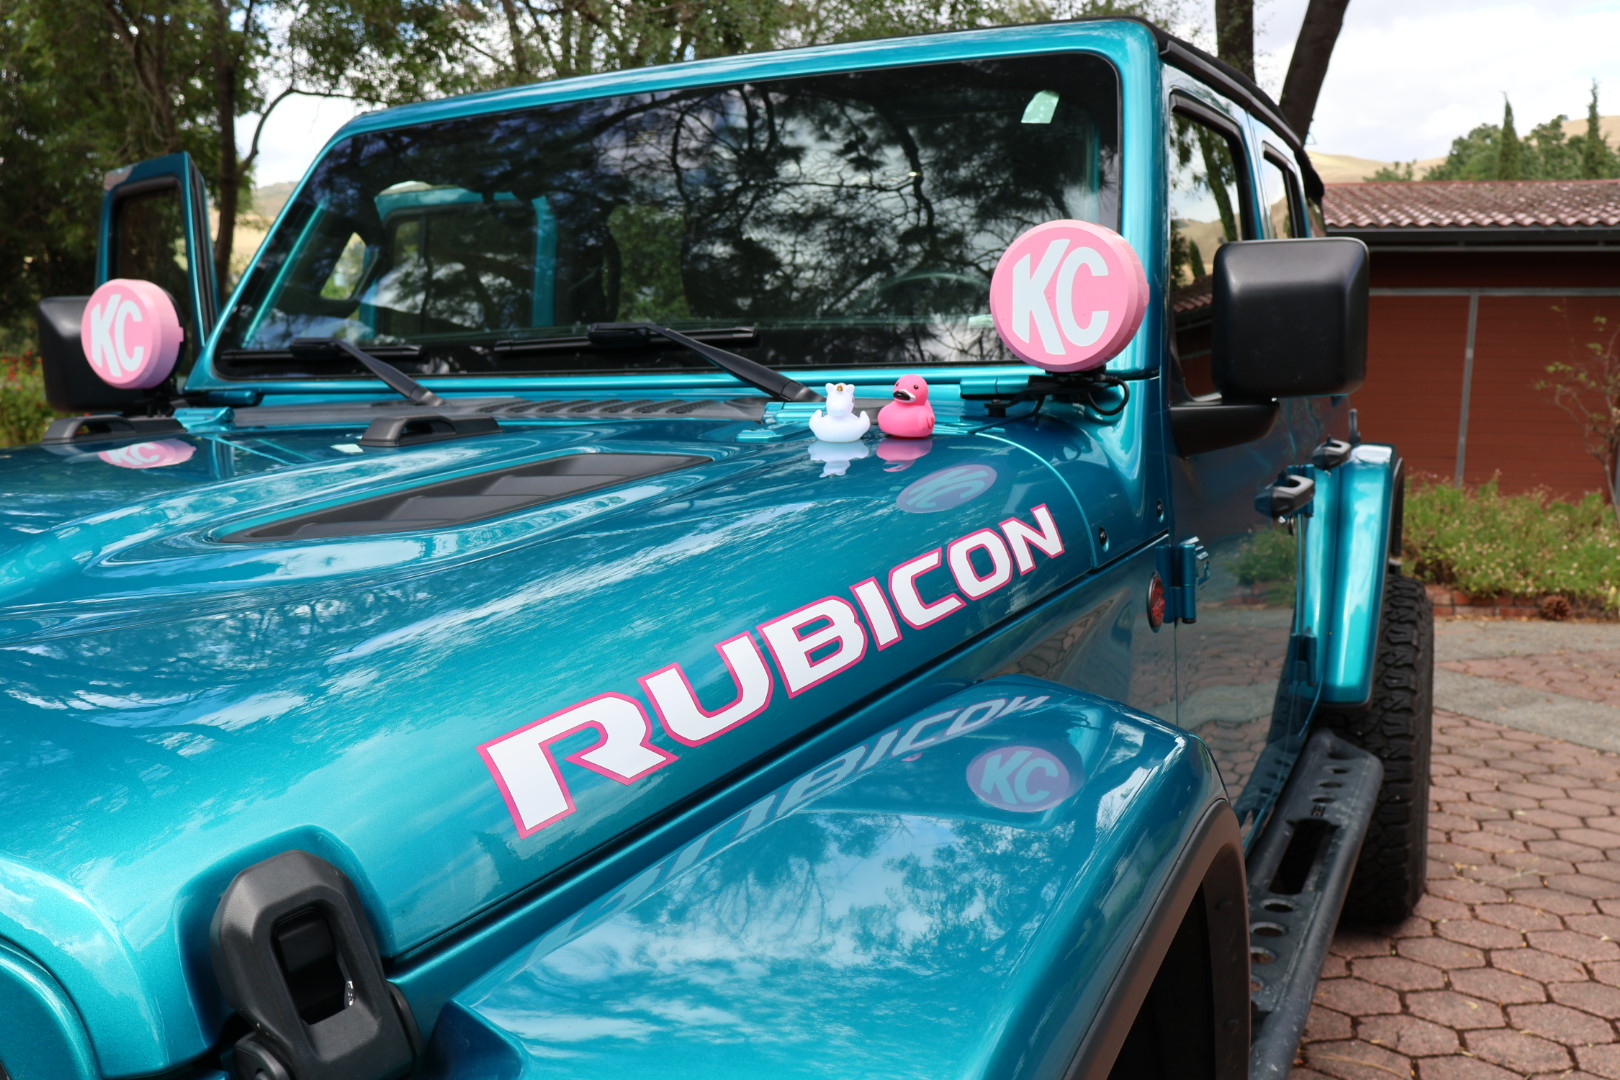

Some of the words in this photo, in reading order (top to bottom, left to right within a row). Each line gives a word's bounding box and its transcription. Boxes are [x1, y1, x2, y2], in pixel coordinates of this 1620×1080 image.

[91, 294, 144, 378] KC
[1012, 239, 1109, 355] KC
[476, 503, 1066, 840] RUBICON
